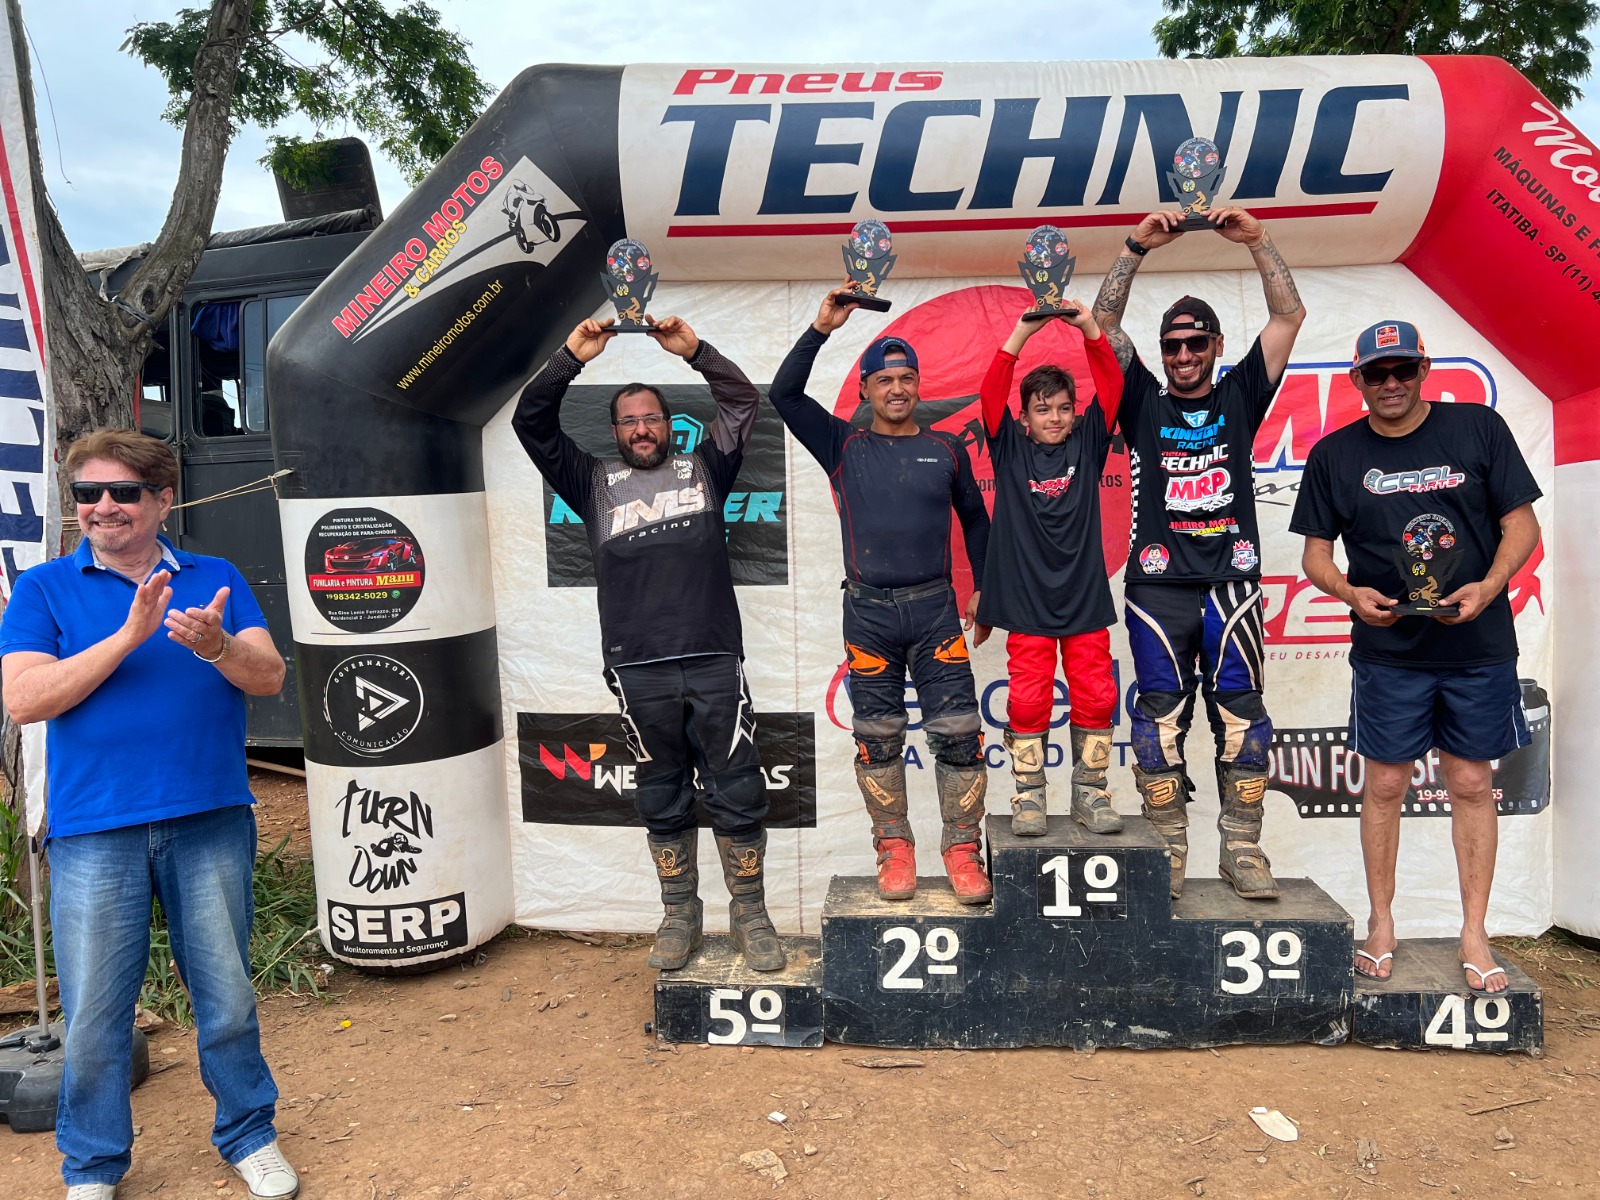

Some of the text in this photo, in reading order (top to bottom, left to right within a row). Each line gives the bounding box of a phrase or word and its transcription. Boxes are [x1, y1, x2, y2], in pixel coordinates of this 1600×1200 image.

[673, 67, 944, 95] Pneus
[661, 83, 1410, 216] TECHNIC
[1493, 146, 1578, 228] MÁQUINAS
[1574, 225, 1592, 241] E
[331, 155, 504, 339] MINEIRO MOTOS
[403, 218, 467, 299] & CARROS
[1486, 188, 1540, 242] ITATIBA
[1544, 245, 1567, 264] SP
[1561, 263, 1593, 292] (11)
[397, 279, 504, 391] www.mineiromotos.com.br
[1169, 470, 1226, 500] MRP
[1409, 478, 1459, 492] PARTS
[628, 520, 691, 541] racing
[313, 579, 340, 587] FUNILARIA
[346, 578, 374, 587] PINTURA
[376, 573, 415, 586] Manu
[334, 659, 411, 684] GOVERNATORI
[1295, 651, 1346, 660] DESAFI
[341, 726, 410, 749] COMUNICAÇÃO
[335, 779, 434, 839] TURN
[1041, 855, 1119, 917] 1º
[331, 900, 461, 943] SERP
[343, 944, 398, 955] Monitoramento
[406, 940, 449, 954] Segurança
[882, 926, 960, 989] 2º
[1220, 930, 1302, 995] 3º
[708, 988, 783, 1045] 5º
[1425, 994, 1511, 1050] 4º
